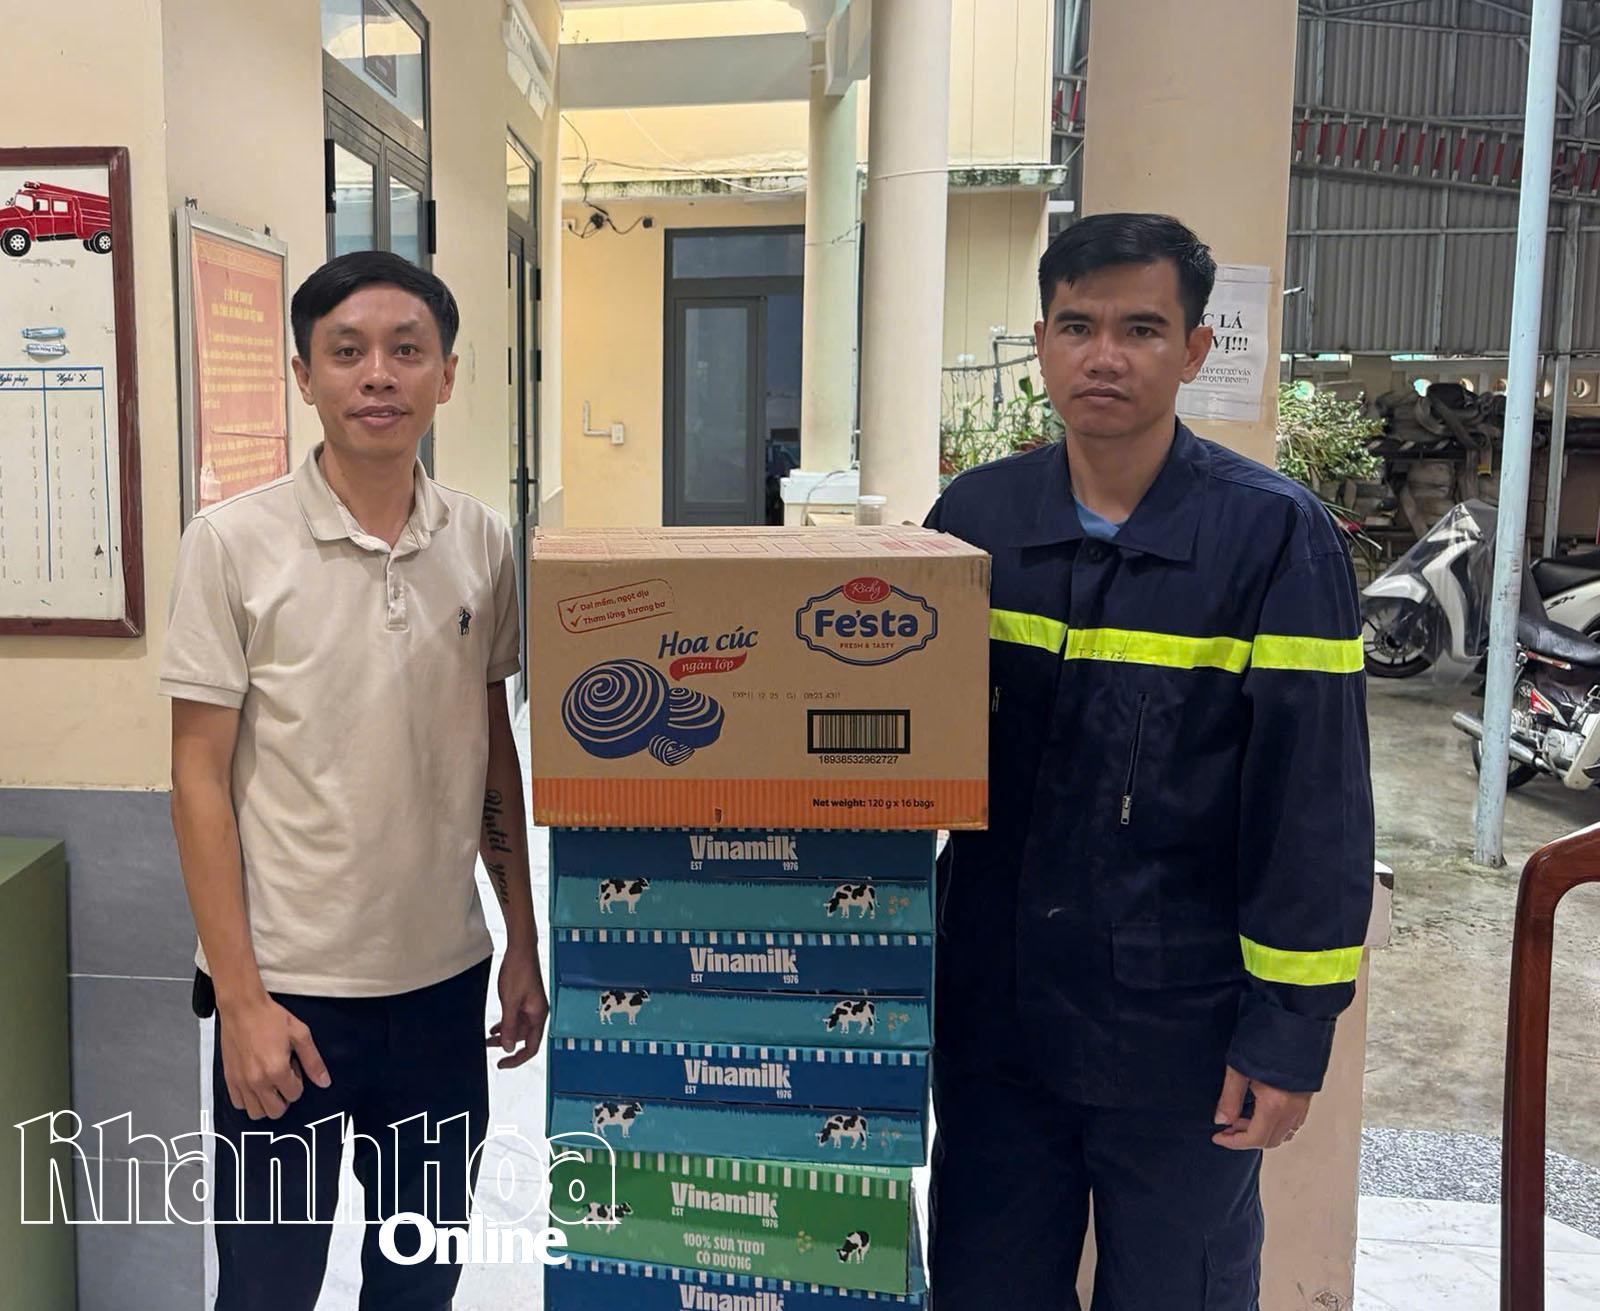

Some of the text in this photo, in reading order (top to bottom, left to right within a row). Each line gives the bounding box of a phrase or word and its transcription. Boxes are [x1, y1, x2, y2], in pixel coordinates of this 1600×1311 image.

[1219, 311, 1242, 329] LÁ
[1212, 335, 1248, 354] VỊ!!!
[658, 626, 759, 659] Hoa cúc
[682, 658, 713, 674] ngàn
[819, 755, 898, 764] 18938532962727
[813, 798, 829, 807] Net
[831, 798, 866, 809] weight:
[869, 799, 884, 807] 120
[885, 800, 892, 809] g
[901, 799, 912, 807] 16
[914, 798, 935, 809] bags
[690, 835, 798, 860] Vinamilk
[690, 861, 799, 871] EST 1976
[690, 947, 798, 973] Vinamilk
[691, 974, 799, 984] EST 1976
[684, 1059, 792, 1089] Vinamilk
[685, 1085, 792, 1099] EST 1976
[671, 1182, 778, 1218] Vinamilk
[672, 1207, 778, 1229] EST 1976
[683, 1231, 712, 1249] 100%
[680, 1283, 785, 1311] Vinamilk
